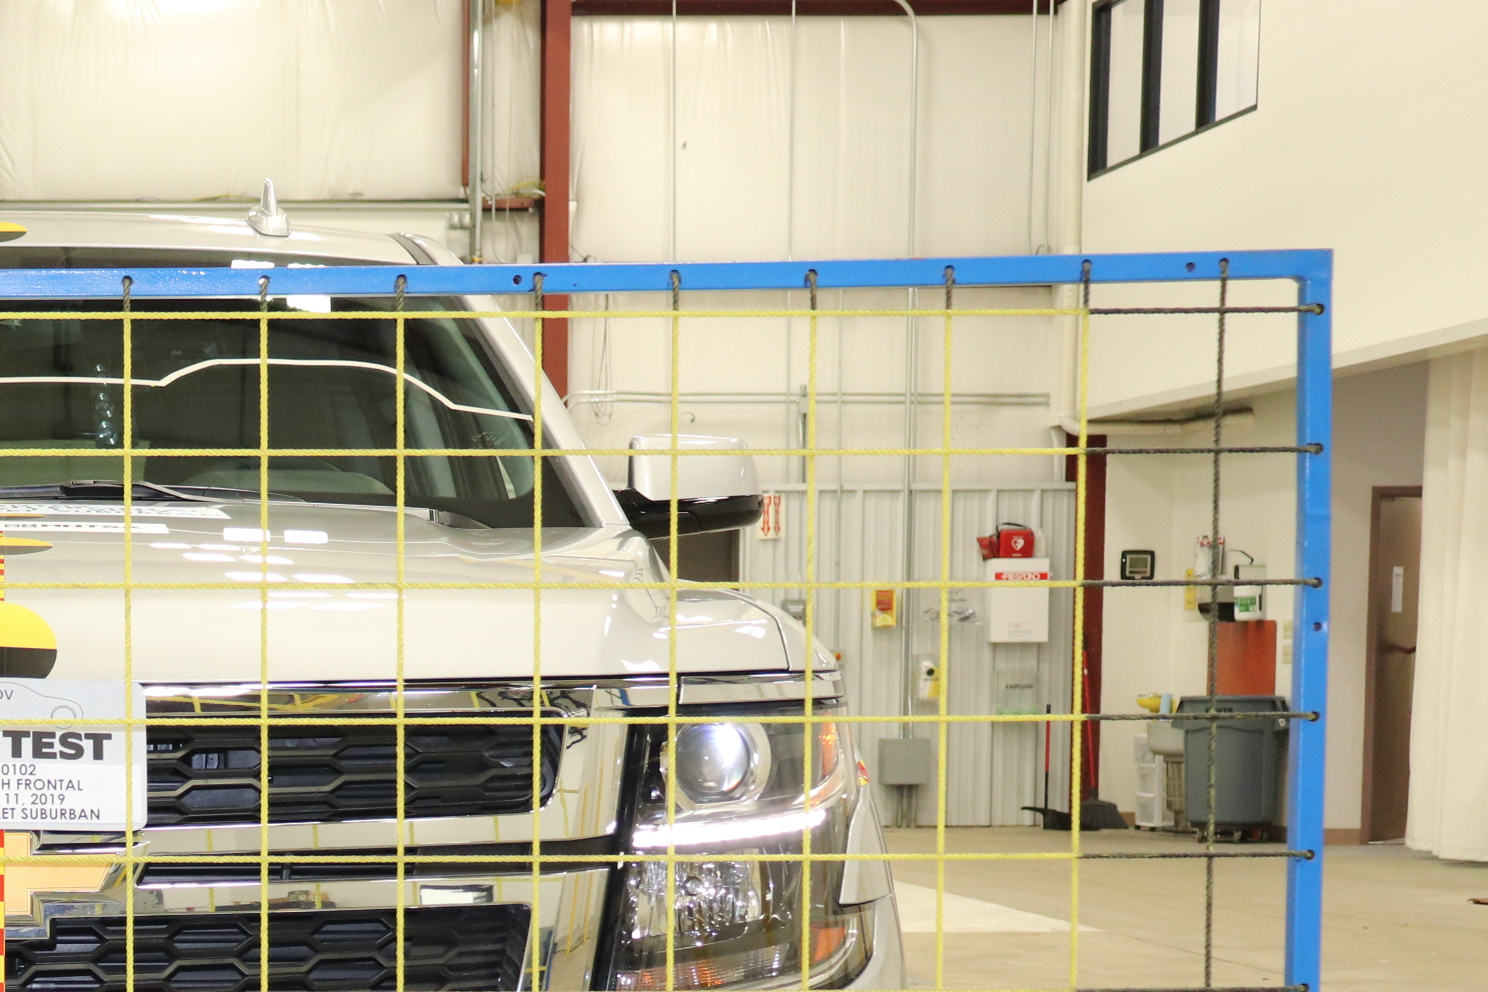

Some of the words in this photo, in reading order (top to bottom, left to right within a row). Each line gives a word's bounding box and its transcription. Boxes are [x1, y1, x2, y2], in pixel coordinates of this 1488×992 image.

[2, 730, 113, 761] TEST
[17, 779, 84, 792] FRONTAL
[5, 793, 25, 806] 11,
[31, 793, 66, 806] 2019
[21, 808, 101, 821] SUBURBAN
